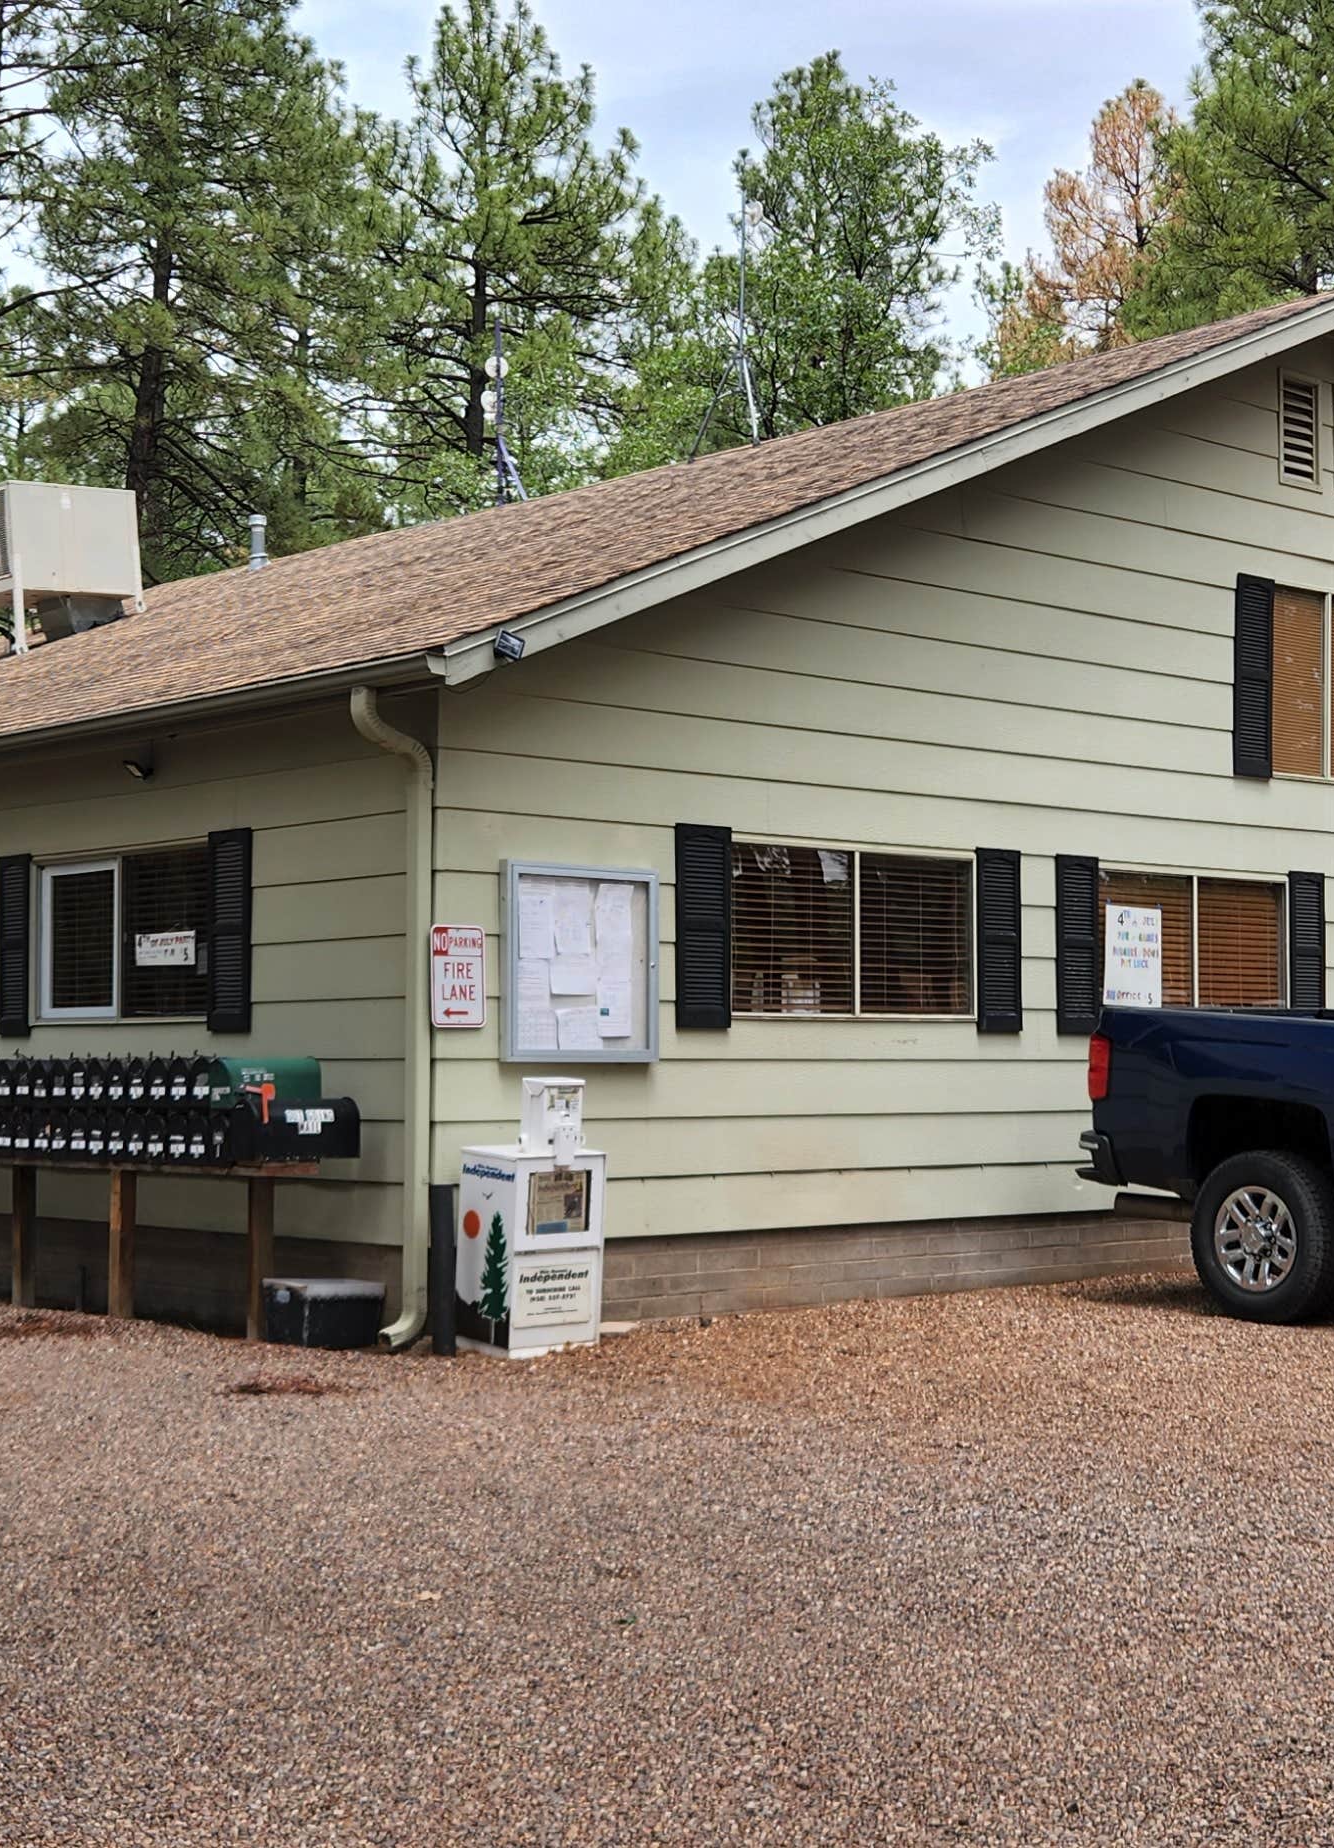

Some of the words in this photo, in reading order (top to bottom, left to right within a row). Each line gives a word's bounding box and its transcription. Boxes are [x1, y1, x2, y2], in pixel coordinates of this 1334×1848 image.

[433, 932, 447, 952] NO
[448, 937, 483, 950] PARKING
[443, 962, 474, 979] FIRE
[442, 983, 476, 1001] LANE
[462, 1163, 515, 1183] Independent
[519, 1269, 589, 1284] Independent
